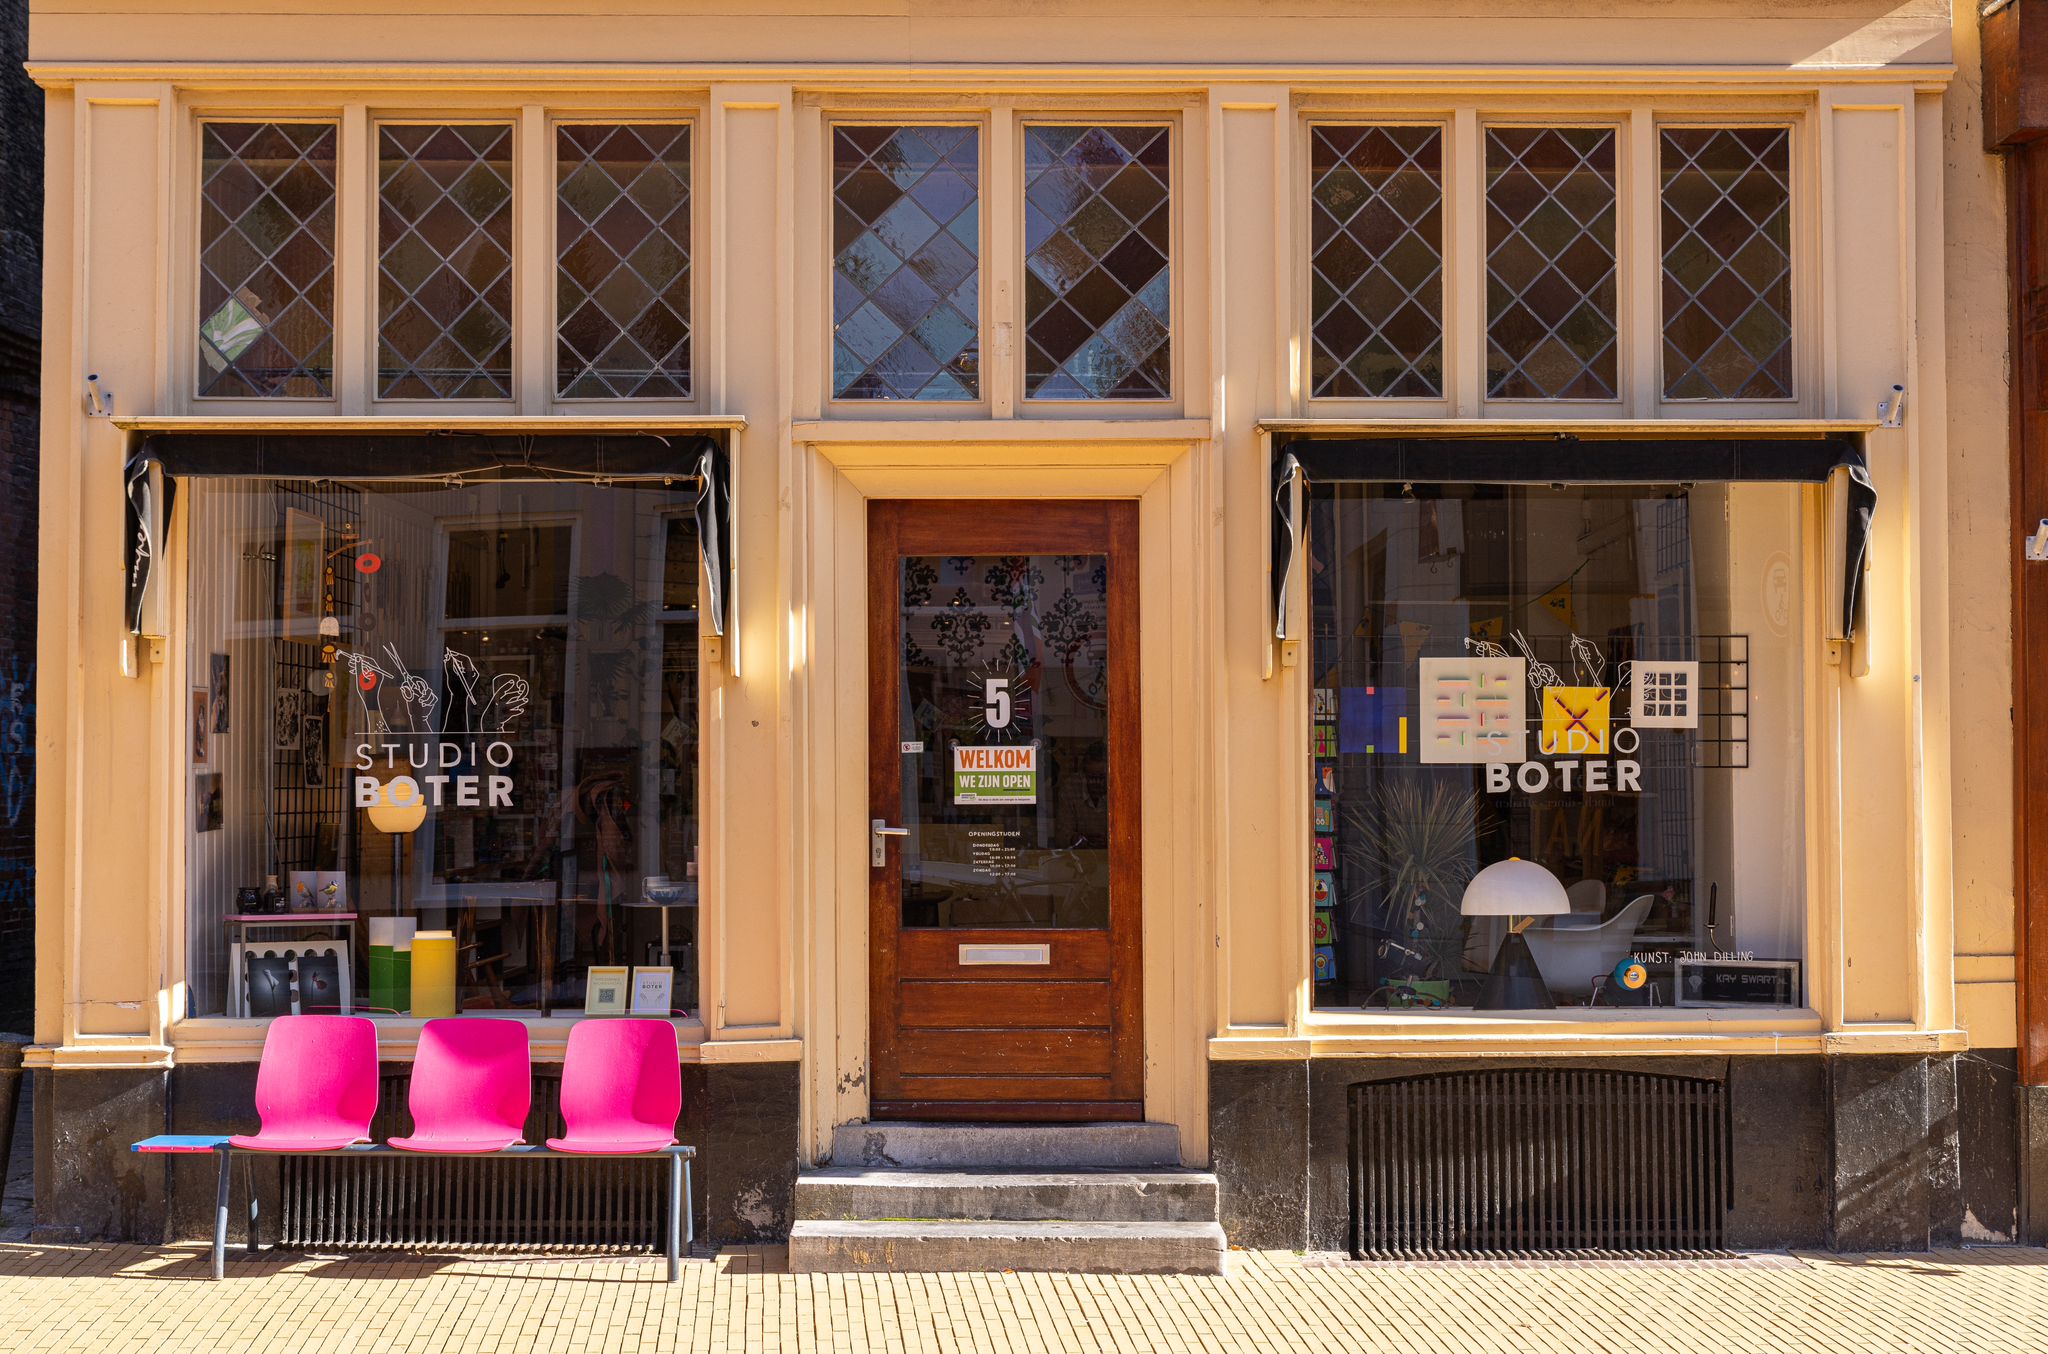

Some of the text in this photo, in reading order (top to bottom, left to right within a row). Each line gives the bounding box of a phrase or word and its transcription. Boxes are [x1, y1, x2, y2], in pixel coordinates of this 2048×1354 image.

[985, 678, 1011, 729] 5
[355, 741, 514, 771] STUDIO
[959, 749, 1031, 769] WELKOM
[959, 774, 1031, 788] WE ZIJN OPEN
[1485, 759, 1643, 794] BOTER
[355, 775, 515, 809] BOTER
[1632, 950, 1755, 965] KUNST: JOHN DILLING
[1715, 973, 1738, 985] KAY
